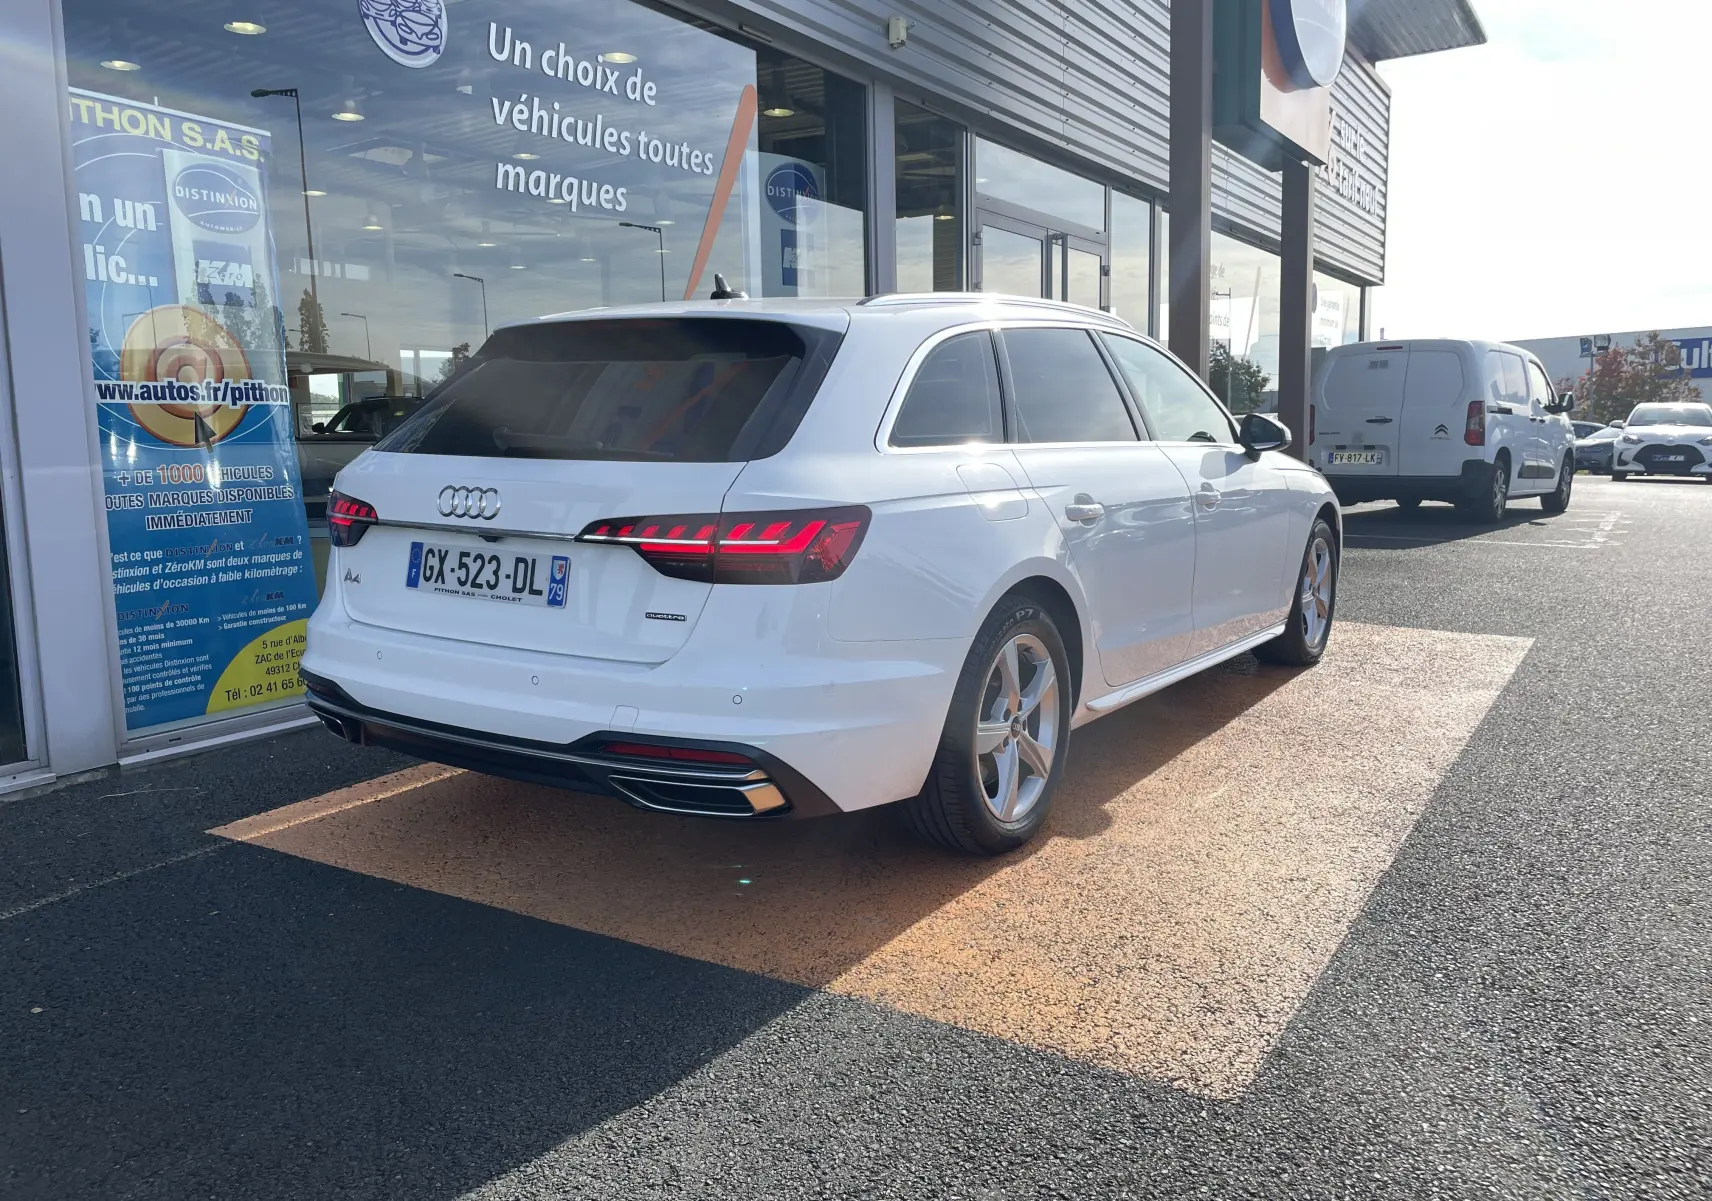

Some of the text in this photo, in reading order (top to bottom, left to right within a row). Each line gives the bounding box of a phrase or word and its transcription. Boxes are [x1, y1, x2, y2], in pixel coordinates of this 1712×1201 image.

[487, 21, 657, 106] Un choix de
[181, 122, 265, 162] S.A.S.
[491, 93, 714, 176] véhicules toutes
[495, 160, 628, 212] marques
[175, 185, 257, 210] DISTINXION
[79, 192, 157, 231] n un
[83, 243, 159, 287] lic...
[1334, 453, 1376, 463] FV-817-LK
[135, 470, 153, 485] DE
[157, 464, 204, 484] 1000
[105, 486, 294, 511] OUTES MARQUES DISPONIBLES
[146, 509, 253, 531] IMMÉDIATEMENT
[130, 552, 142, 561] ce
[144, 550, 163, 561] que
[235, 541, 245, 551] et
[112, 550, 303, 579] stinxion et ZéroKM sont deux marques de
[411, 568, 417, 579] F
[423, 548, 543, 596] GX-523-DL
[112, 581, 151, 595] éhicules
[153, 575, 208, 590] d'occasion
[210, 573, 217, 583] à
[218, 571, 242, 583] faible
[344, 567, 362, 585] A4
[434, 587, 460, 595] PITHON
[490, 594, 523, 602] CHOLET
[549, 583, 564, 601] 79
[117, 600, 189, 620] DISTINXION
[1015, 608, 1034, 621] P7
[262, 641, 268, 650] 5
[270, 639, 284, 648] rue
[255, 652, 272, 665] ZAC
[273, 651, 284, 661] de
[265, 663, 291, 676] 49312
[225, 688, 241, 701] Tél
[249, 683, 264, 697] 02
[266, 681, 278, 693] 41
[281, 678, 295, 690] 65
